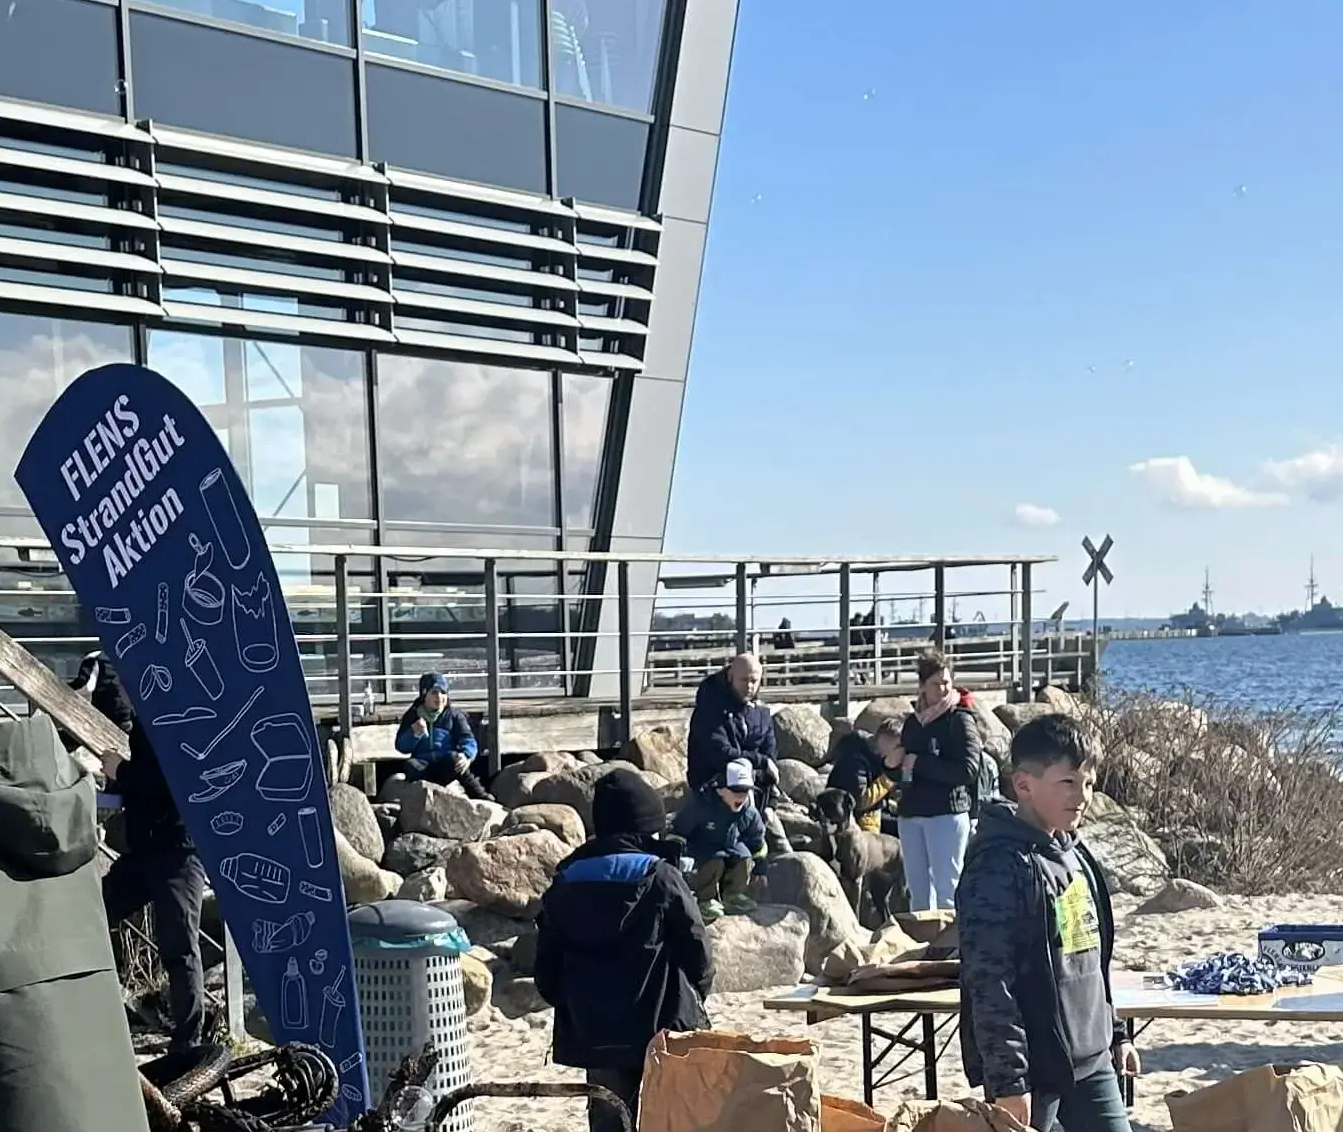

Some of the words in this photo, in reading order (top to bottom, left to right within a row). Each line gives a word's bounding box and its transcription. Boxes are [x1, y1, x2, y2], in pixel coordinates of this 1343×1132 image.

[60, 393, 140, 502] FLENS
[60, 413, 186, 566] StrandGut
[101, 484, 185, 589] Aktion
